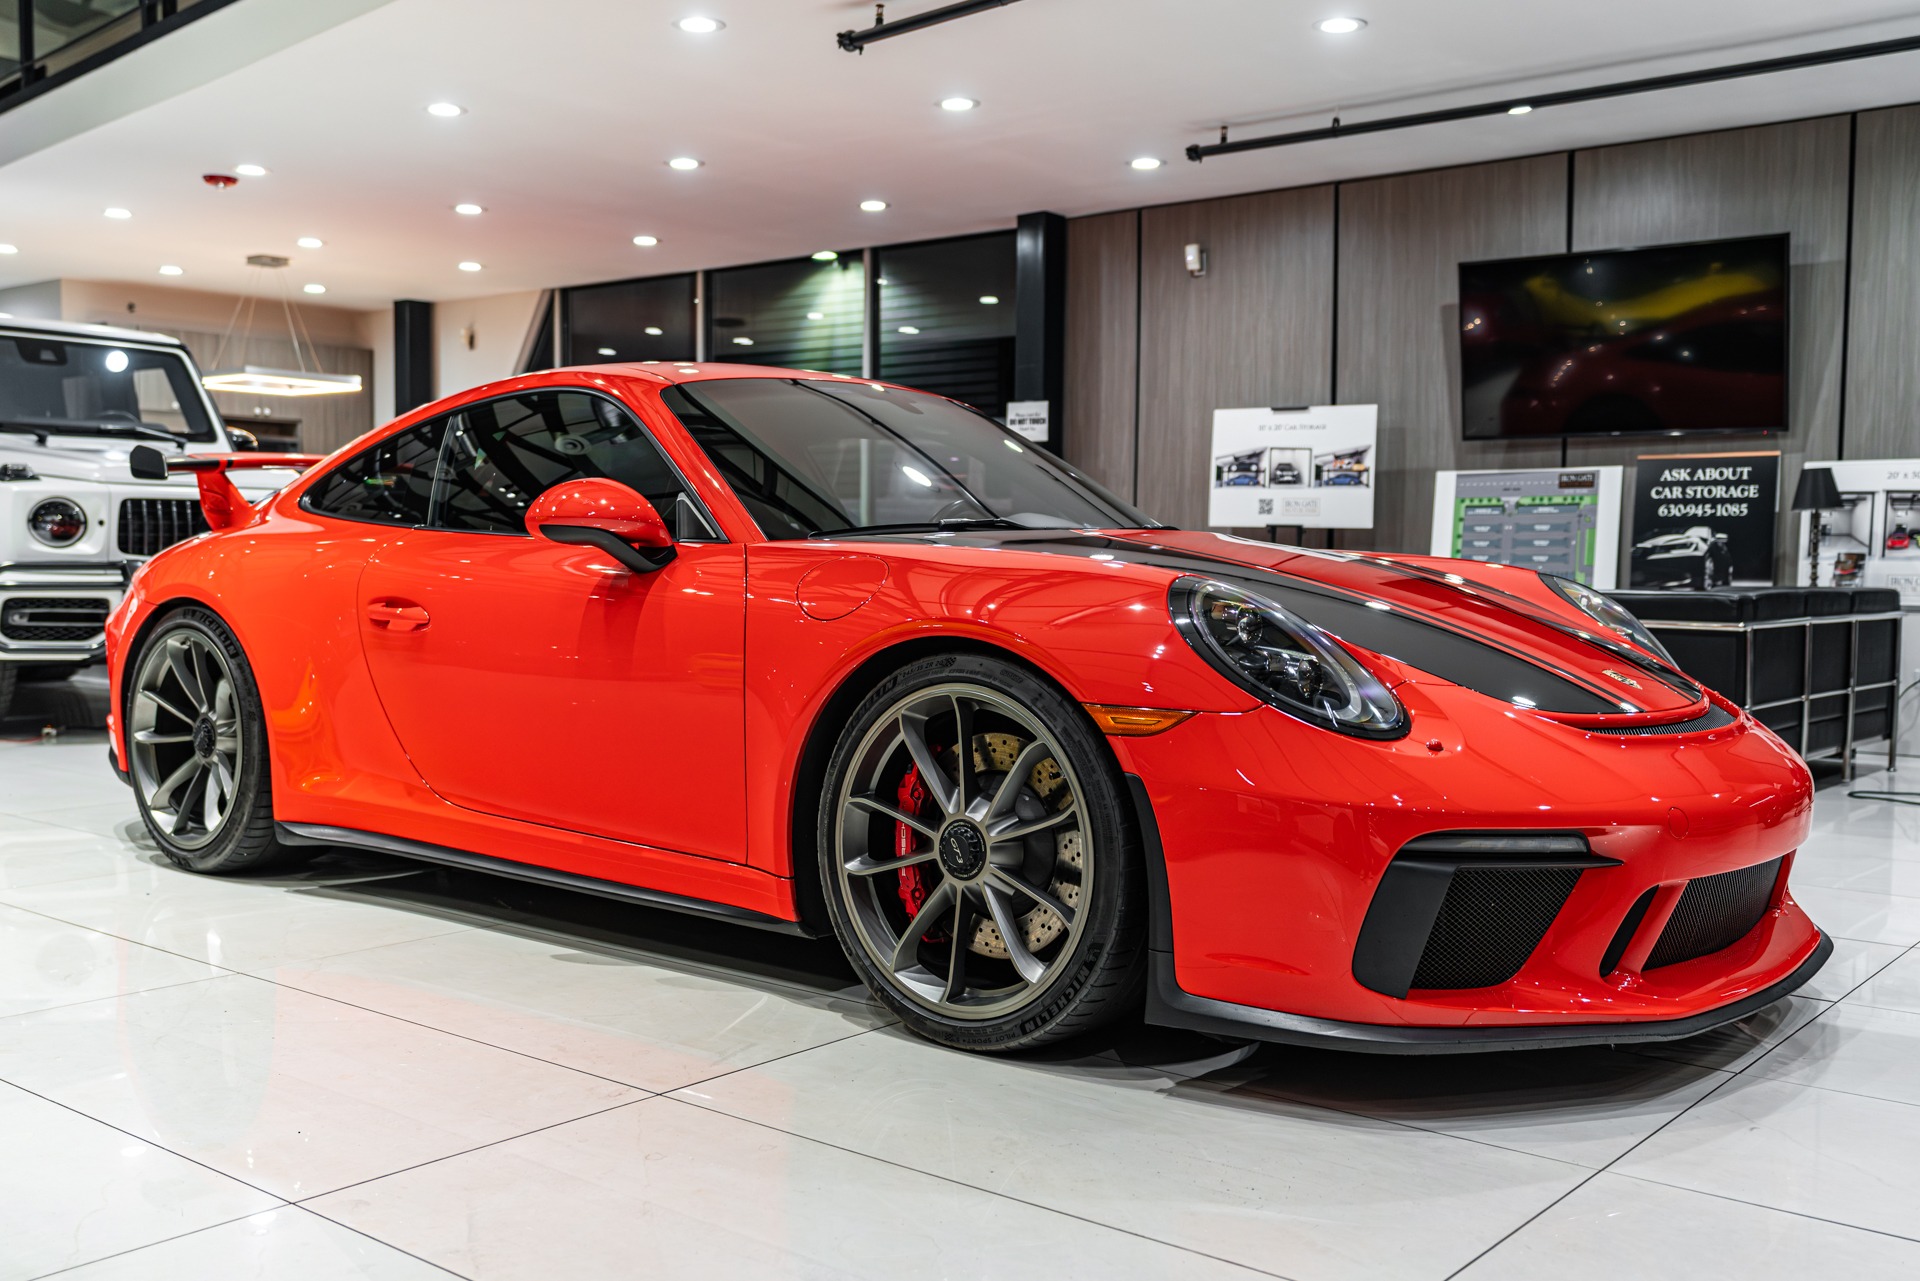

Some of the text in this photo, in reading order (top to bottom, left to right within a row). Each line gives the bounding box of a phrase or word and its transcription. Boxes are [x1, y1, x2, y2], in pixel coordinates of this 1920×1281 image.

[1660, 466, 1752, 482] ASK ABOUT
[1650, 484, 1760, 499] CAR STORAGE
[1657, 503, 1749, 518] 630-945-1085
[950, 837, 963, 864] GT3
[1024, 964, 1091, 1033] MICHELIN
